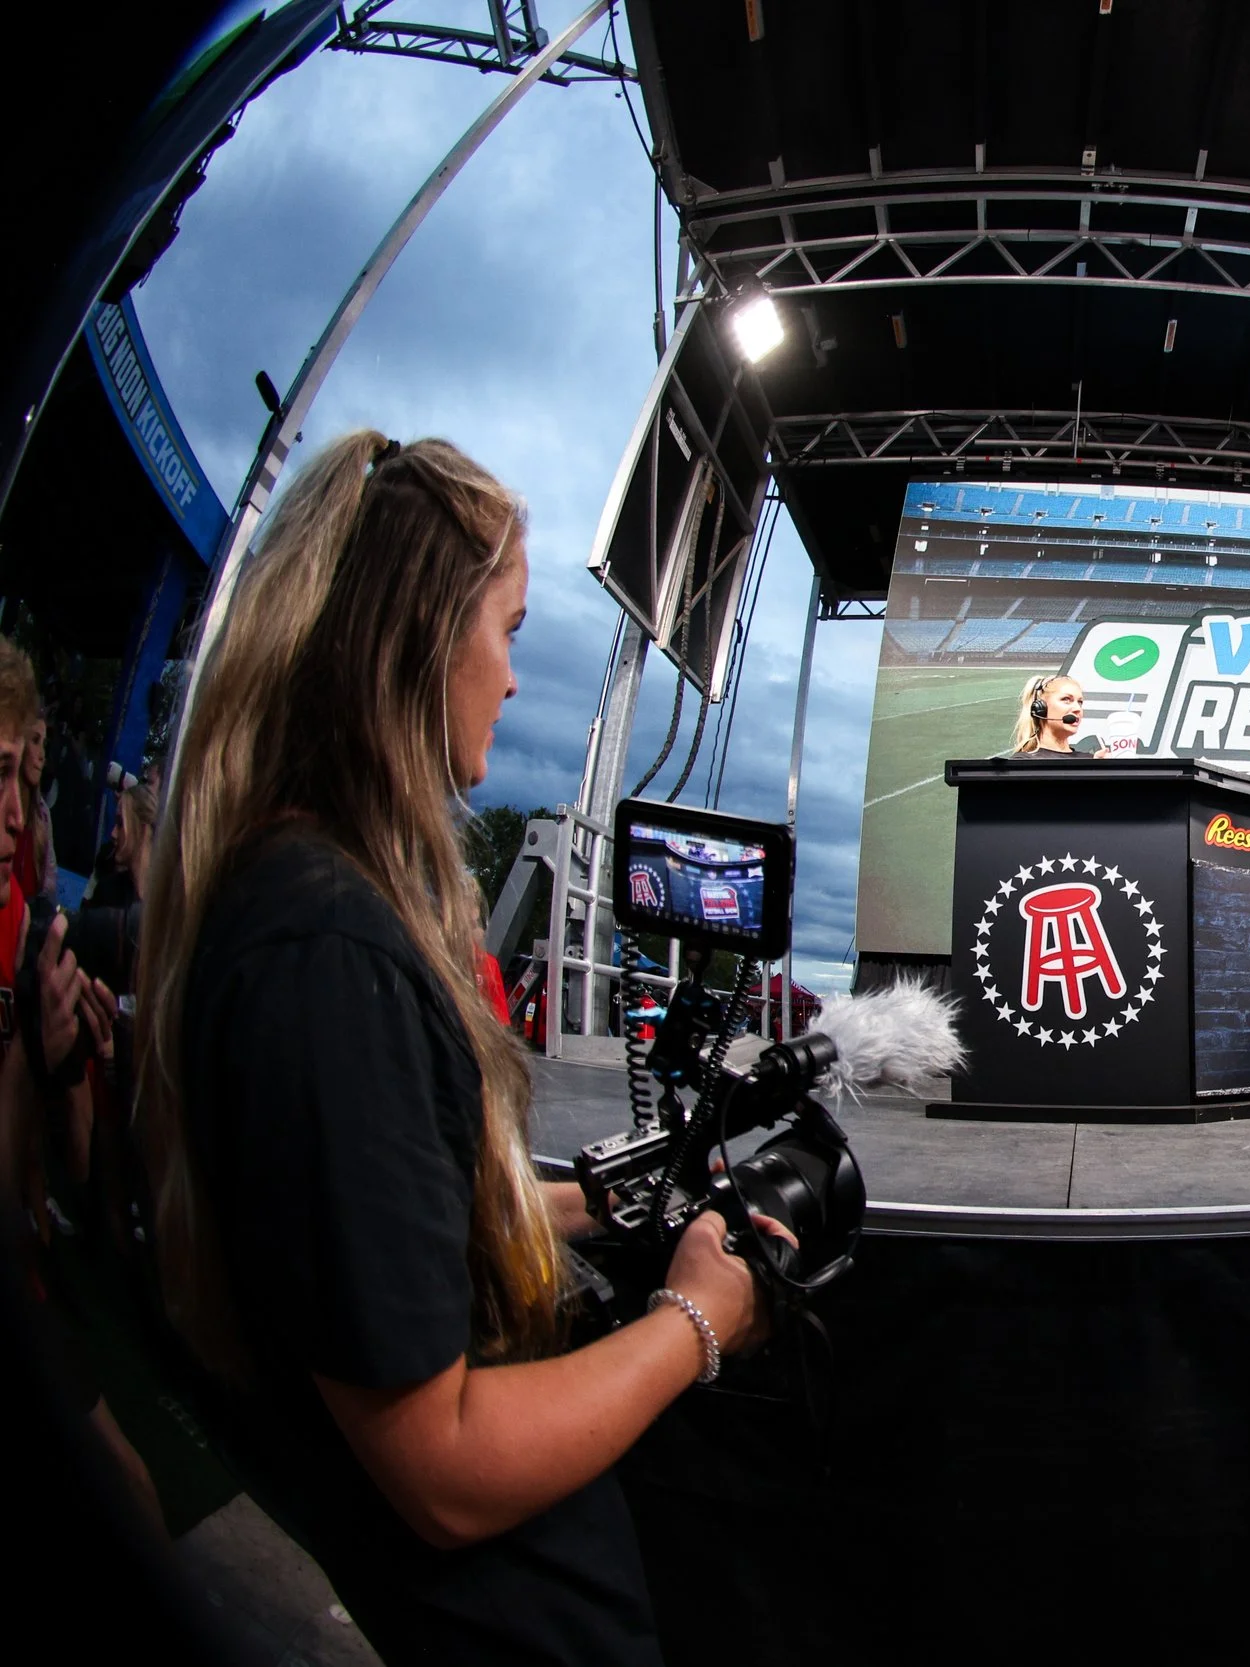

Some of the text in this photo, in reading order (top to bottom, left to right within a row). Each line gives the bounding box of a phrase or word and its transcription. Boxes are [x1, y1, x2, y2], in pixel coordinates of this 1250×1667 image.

[96, 304, 197, 508] BIG NOON KICKOFF
